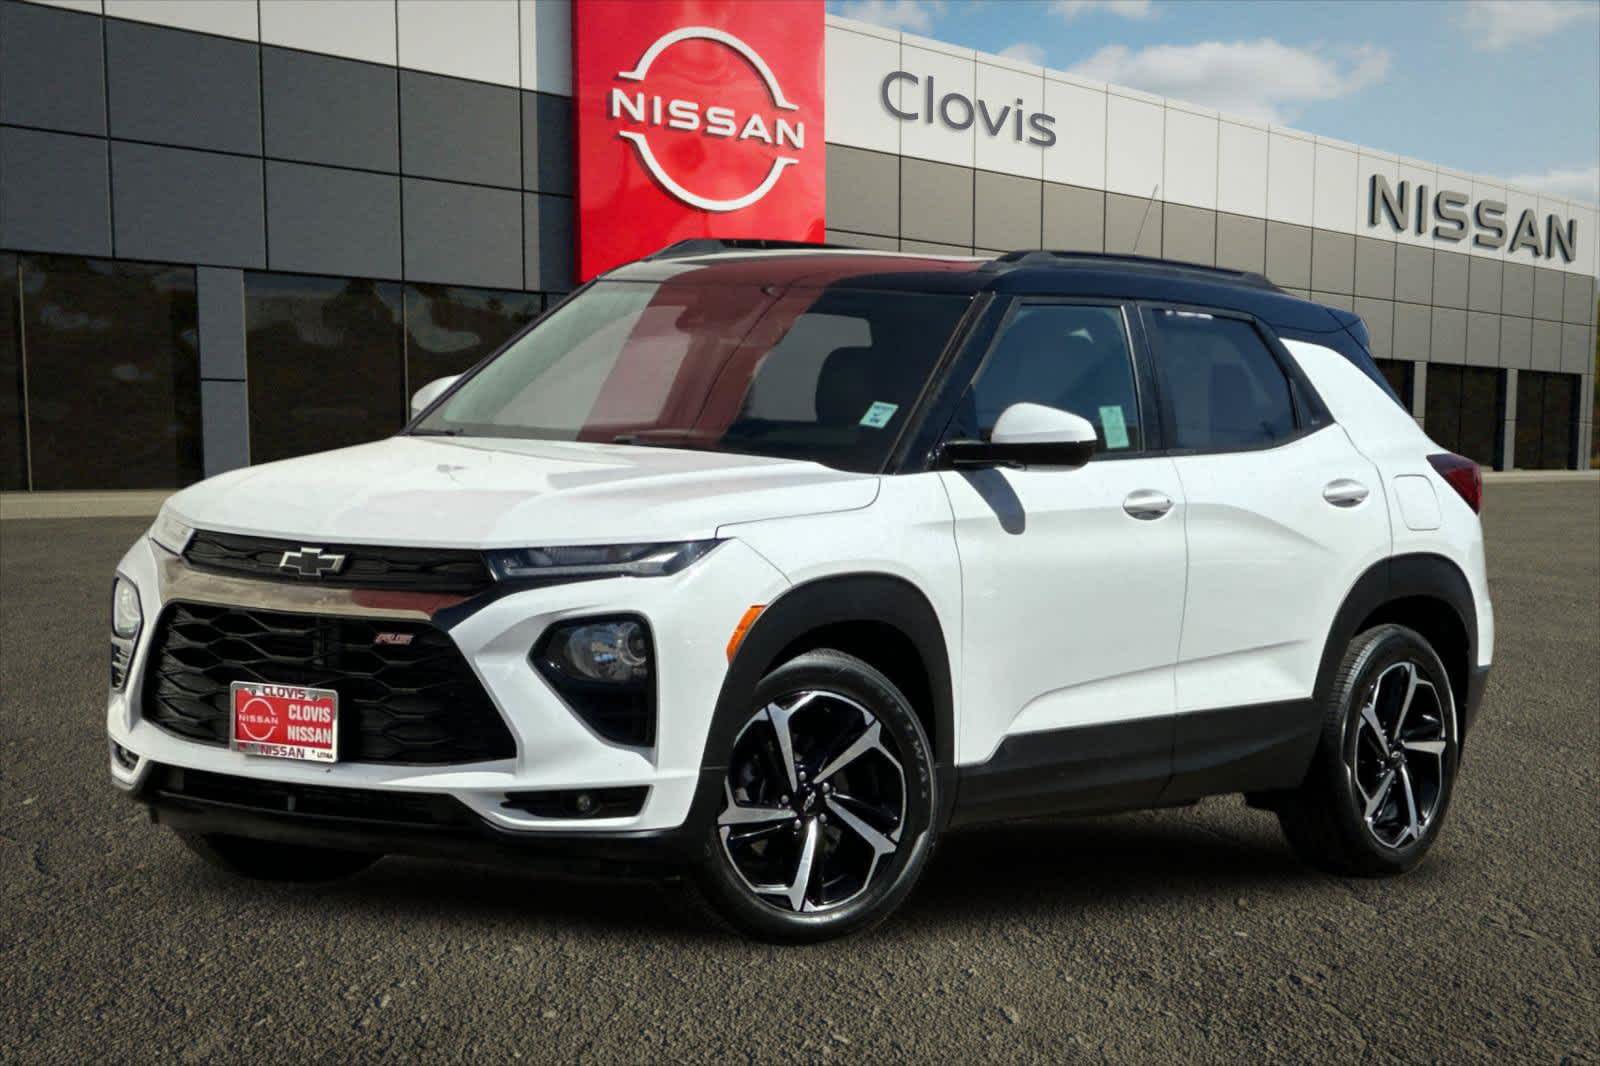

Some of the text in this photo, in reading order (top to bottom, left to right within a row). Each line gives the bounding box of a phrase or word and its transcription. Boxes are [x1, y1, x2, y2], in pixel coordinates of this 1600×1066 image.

[612, 87, 805, 149] NISSAN
[881, 70, 1057, 147] Clovis
[1368, 173, 1577, 264] NISSAN
[262, 687, 306, 700] CLOVIS
[238, 713, 279, 725] NISSAN
[288, 703, 331, 723] CLOVIS
[287, 724, 332, 745] NISSAN
[260, 743, 305, 759] NISSAN
